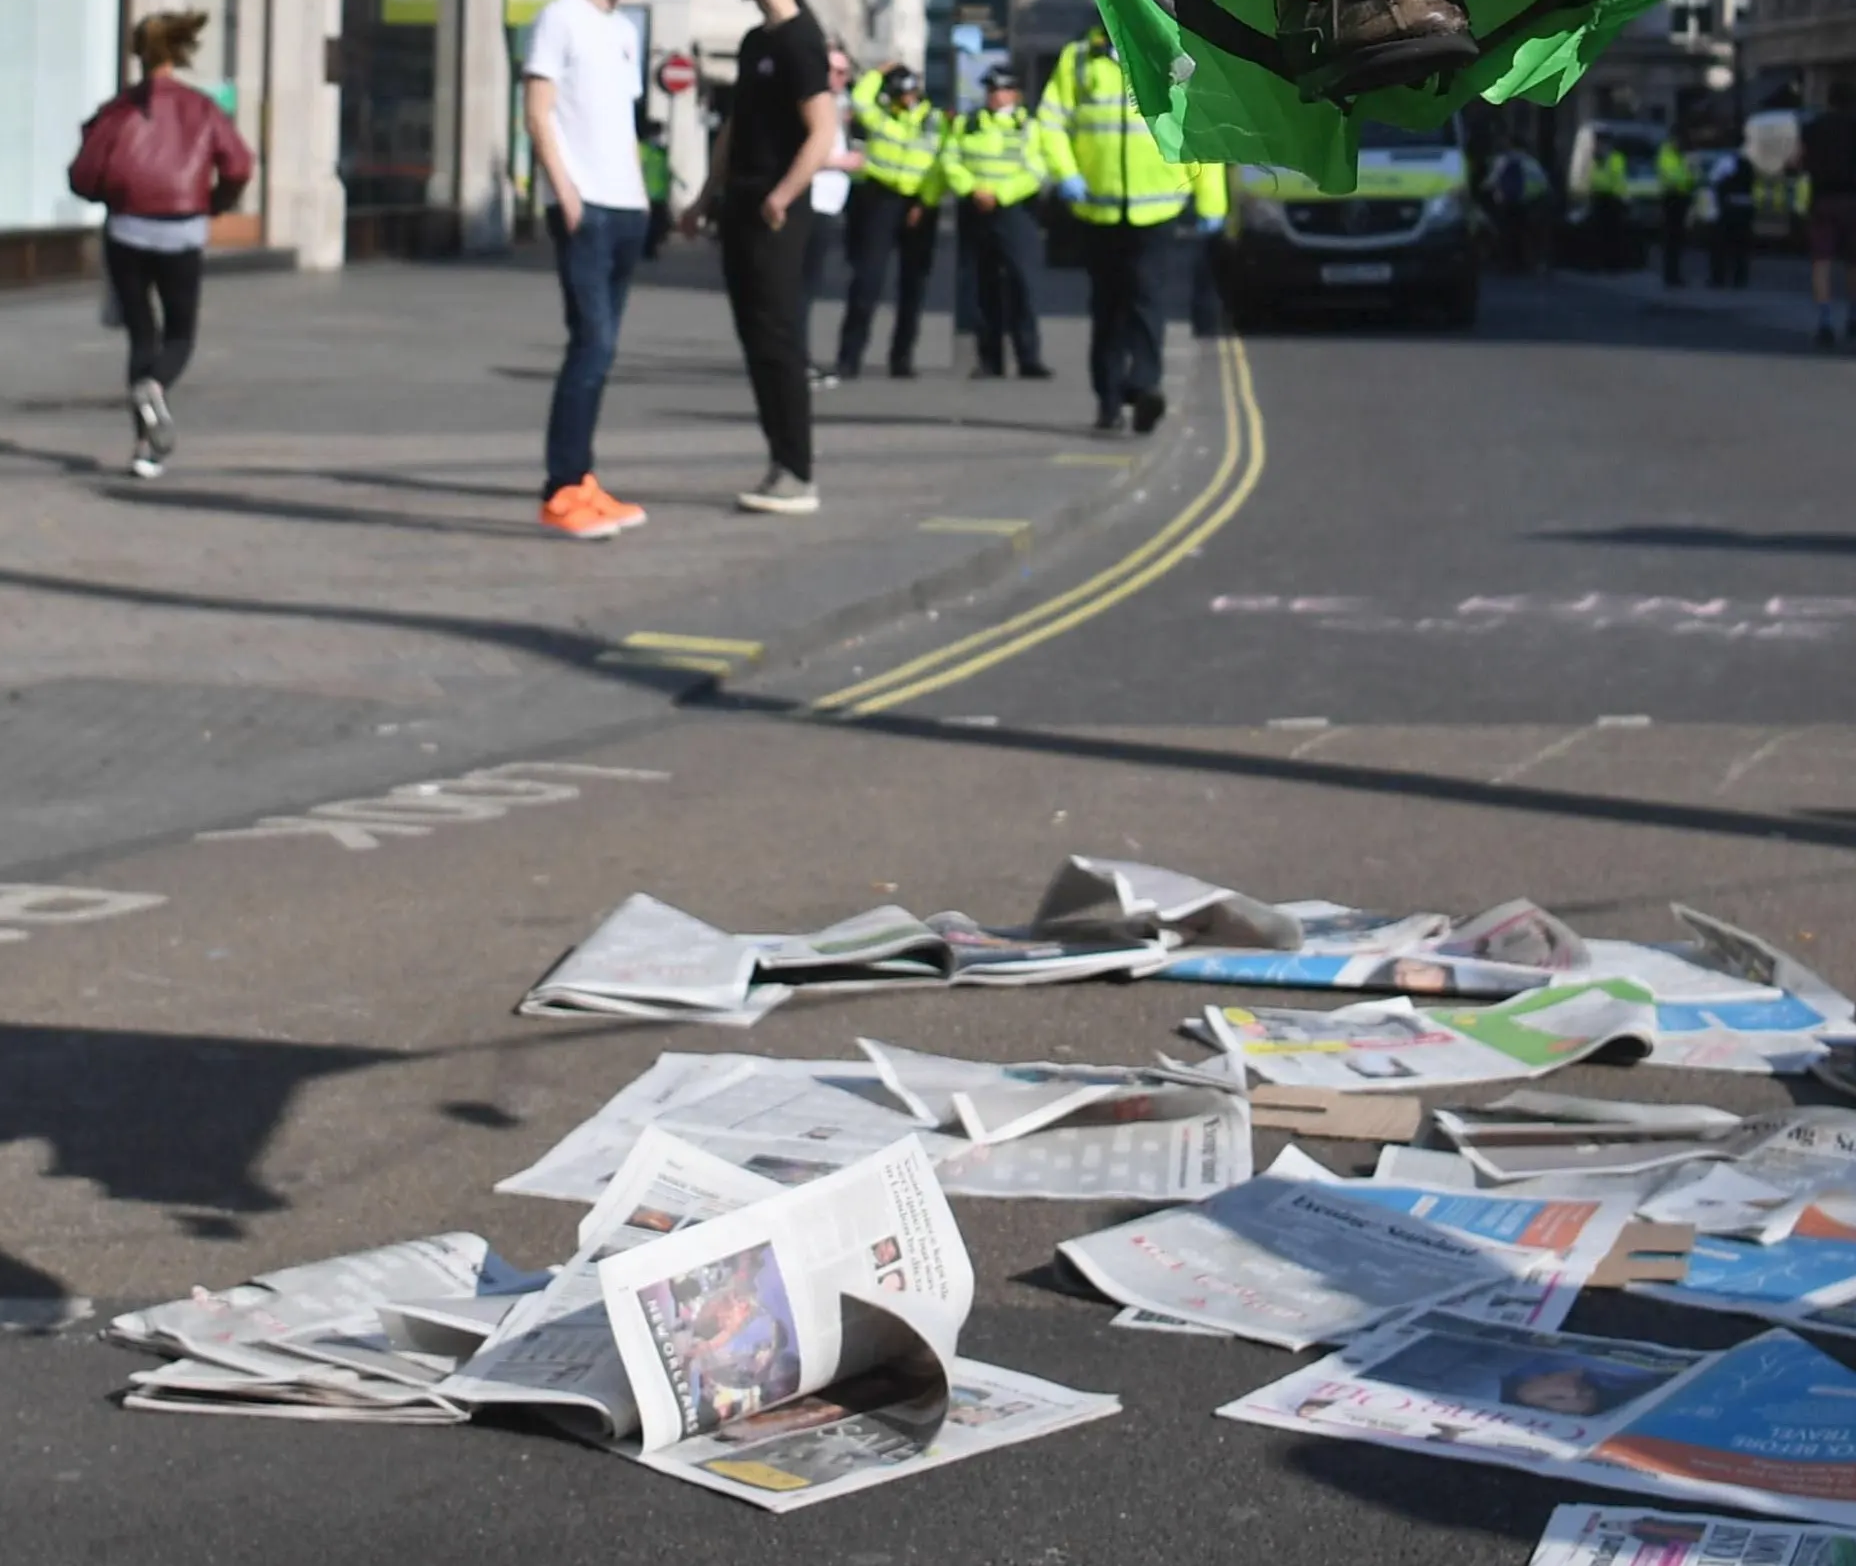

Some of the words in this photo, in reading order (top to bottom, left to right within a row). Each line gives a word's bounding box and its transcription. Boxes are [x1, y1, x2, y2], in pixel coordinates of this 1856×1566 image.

[192, 759, 674, 850] LOOK
[645, 1297, 671, 1340] NEW
[662, 1342, 703, 1433] ORLEANS
[1729, 1431, 1816, 1453] BEFORE
[1767, 1422, 1854, 1442] TRAVEL
